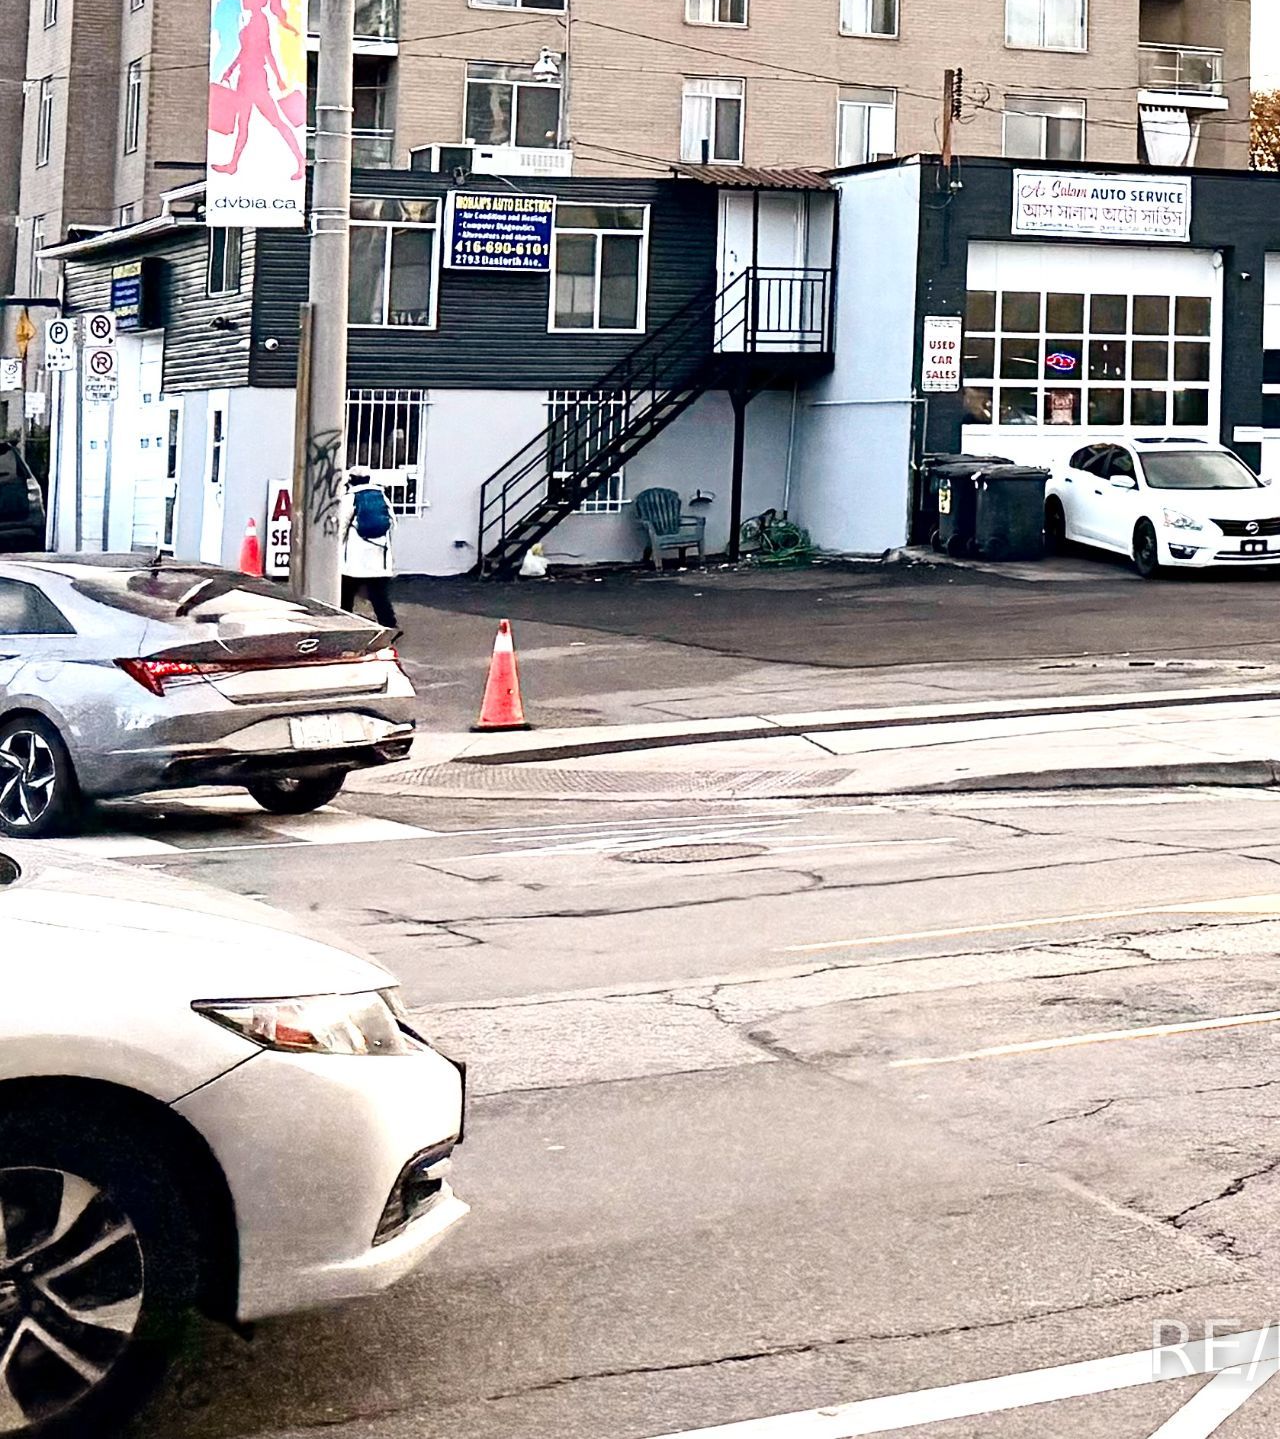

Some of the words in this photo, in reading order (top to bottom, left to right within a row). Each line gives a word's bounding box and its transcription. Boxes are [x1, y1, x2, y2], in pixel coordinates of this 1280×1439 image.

[1051, 180, 1087, 199] Salam
[1090, 188, 1126, 201] AUTO
[1130, 190, 1184, 204] SERVICE
[214, 196, 296, 209] dvbia.ca
[492, 197, 513, 212] AUTO
[514, 198, 553, 213] ELECTRIC
[454, 240, 549, 255] 416-690-6101
[481, 255, 522, 266] Danforth
[929, 340, 956, 350] USED
[931, 355, 953, 365] CAR
[925, 370, 957, 379] SALES
